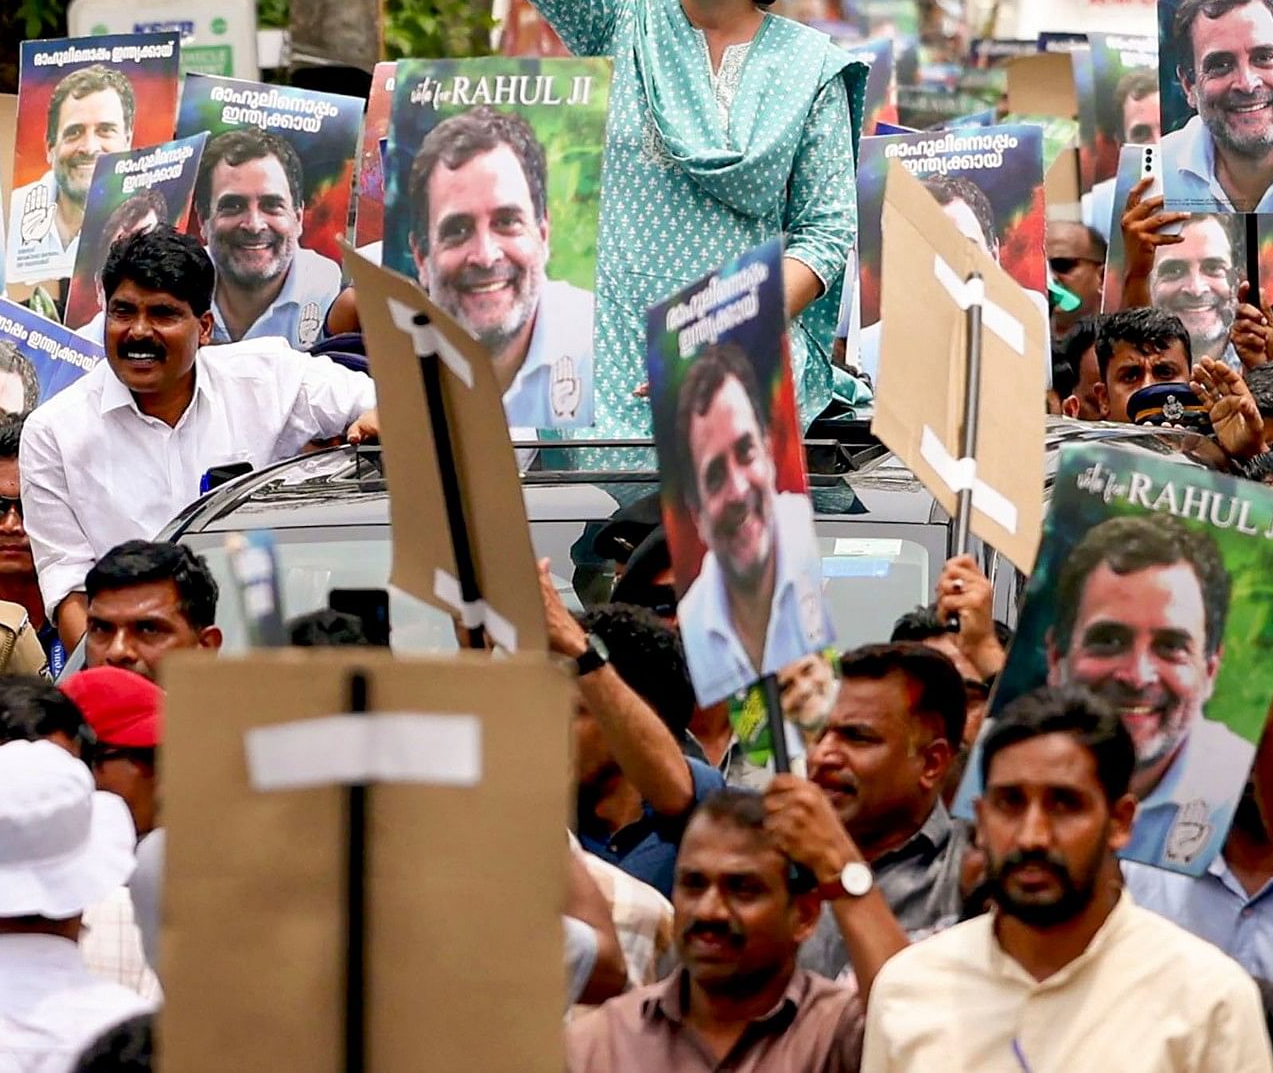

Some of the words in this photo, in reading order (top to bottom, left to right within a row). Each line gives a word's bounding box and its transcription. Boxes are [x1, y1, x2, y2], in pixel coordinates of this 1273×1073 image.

[210, 85, 338, 119] രാഹുലിനൊപ്പം
[451, 75, 561, 105] RAHUL
[567, 75, 593, 105] JI
[222, 105, 322, 133] ഇന്ത്യക്കായ്
[1127, 471, 1257, 535] RAHUL
